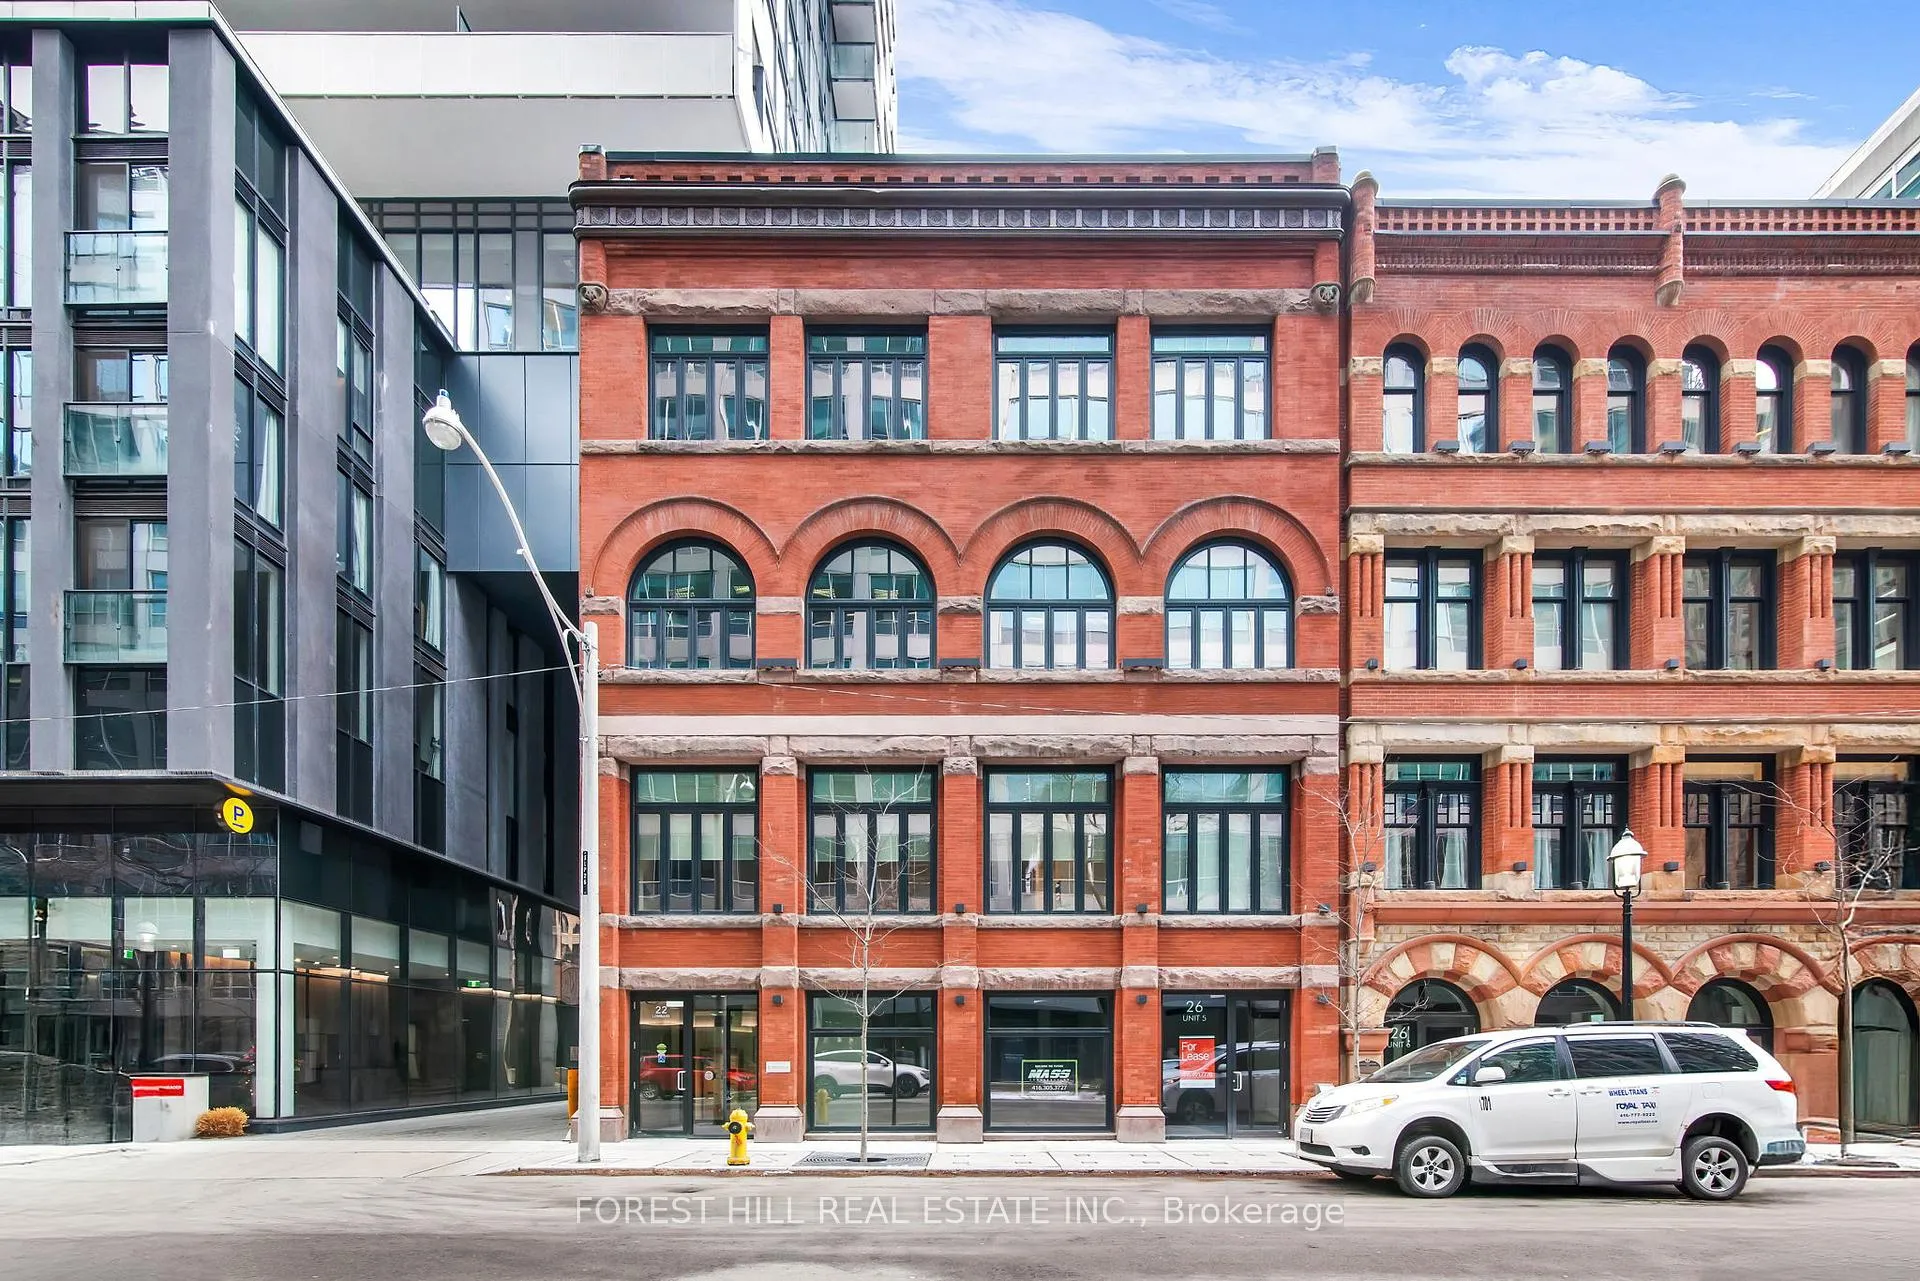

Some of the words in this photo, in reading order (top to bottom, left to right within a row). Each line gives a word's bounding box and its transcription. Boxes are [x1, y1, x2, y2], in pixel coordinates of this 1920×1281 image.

[233, 805, 245, 821] P
[655, 1005, 668, 1014] 22
[1186, 1000, 1204, 1013] 26
[1391, 1026, 1408, 1039] 26
[1181, 1042, 1197, 1051] For
[1181, 1052, 1209, 1061] Lease
[1028, 1069, 1071, 1079] MASS
